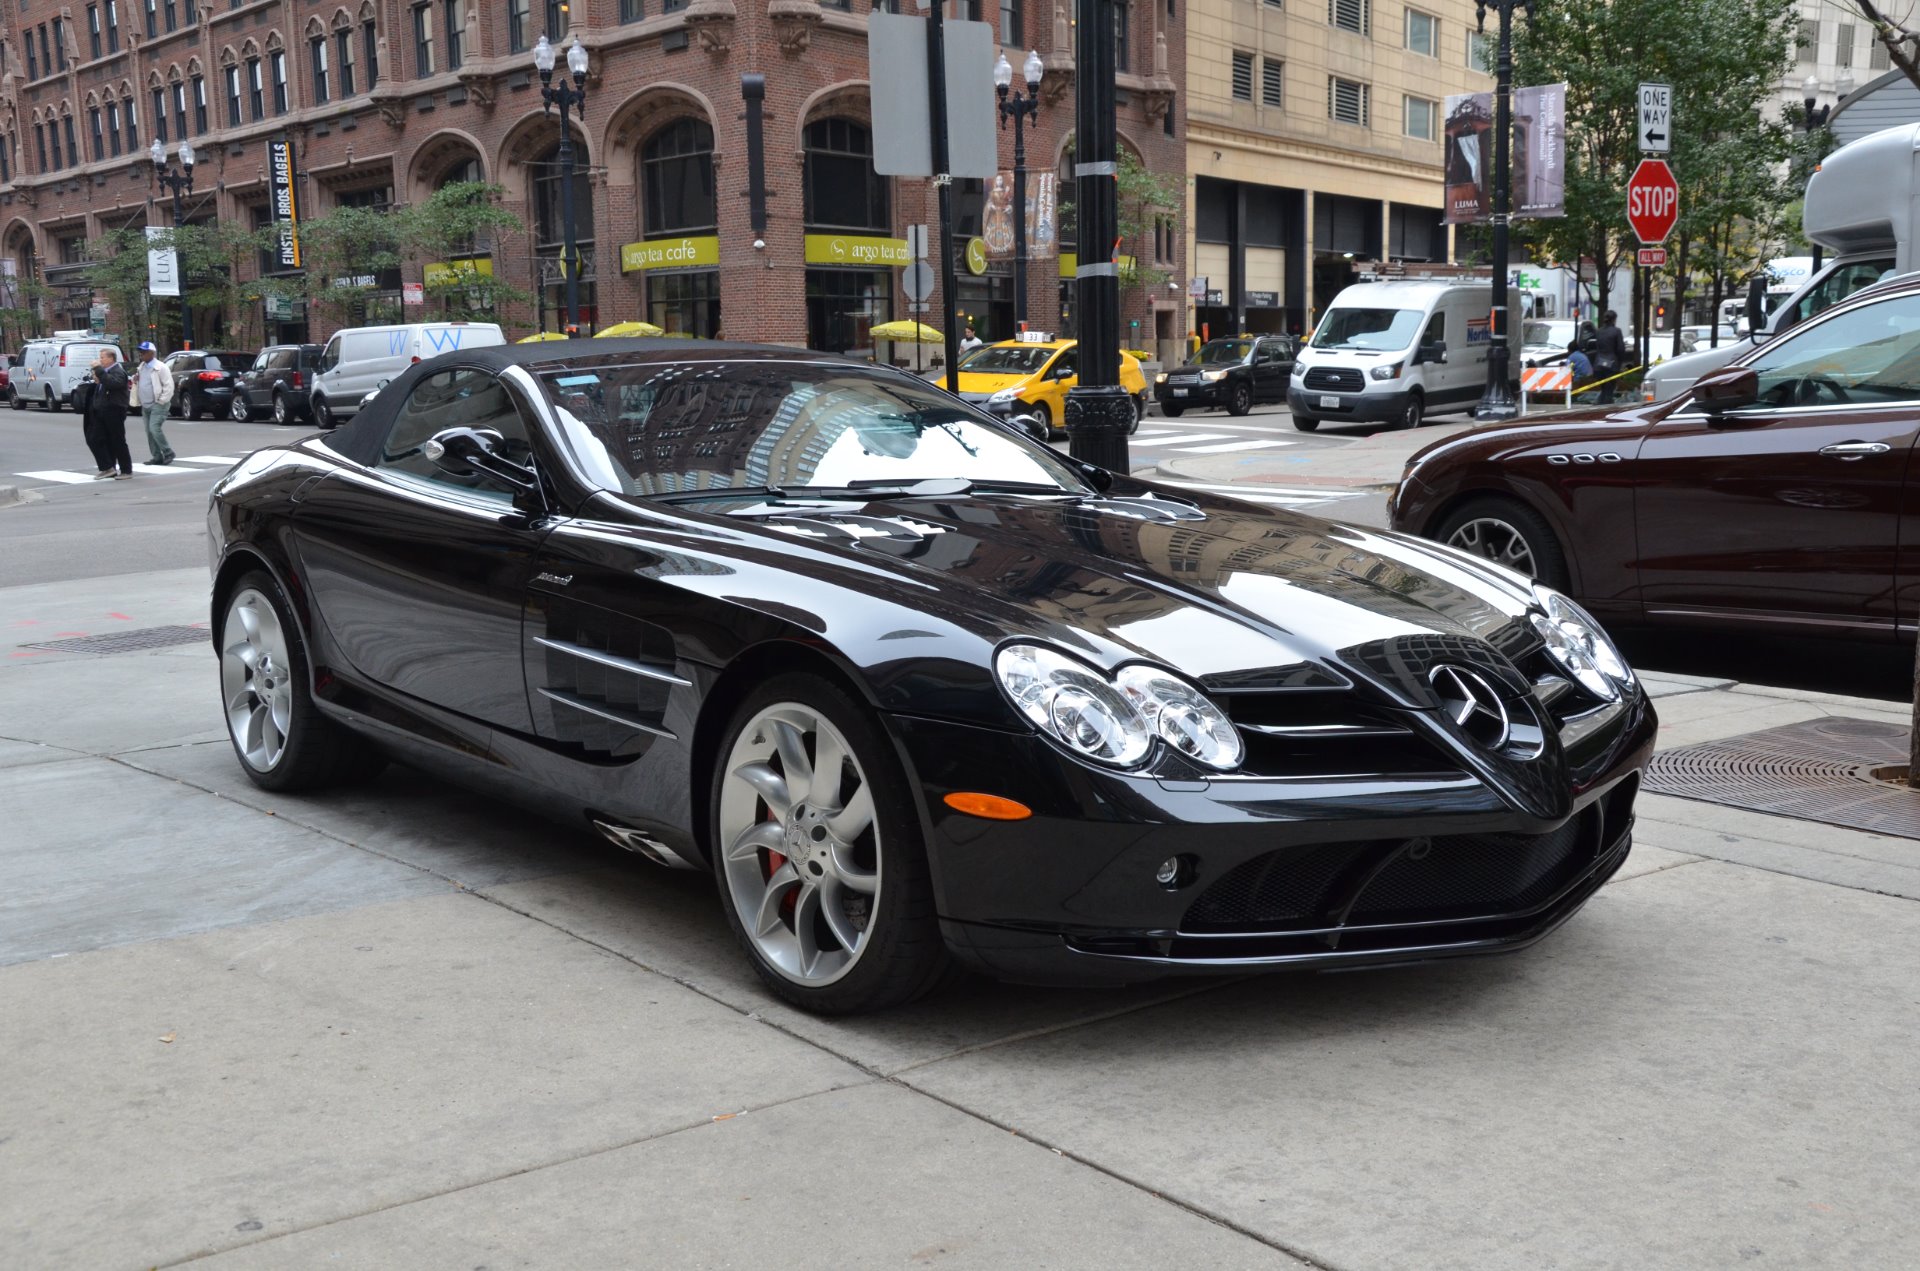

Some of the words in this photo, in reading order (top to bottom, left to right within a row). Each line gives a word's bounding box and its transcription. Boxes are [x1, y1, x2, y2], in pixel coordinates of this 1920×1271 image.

[1643, 91, 1667, 107] ONE
[1643, 109, 1667, 125] WAY
[273, 143, 288, 184] BAGELS
[1454, 200, 1479, 208] LUMA
[1631, 186, 1675, 217] STOP
[631, 250, 647, 267] argo
[648, 248, 663, 262] tea
[666, 240, 696, 260] café
[852, 245, 879, 262] argo
[881, 244, 895, 258] tea
[1641, 252, 1652, 262] ALL
[1653, 252, 1664, 262] WAY
[424, 327, 462, 352] W
